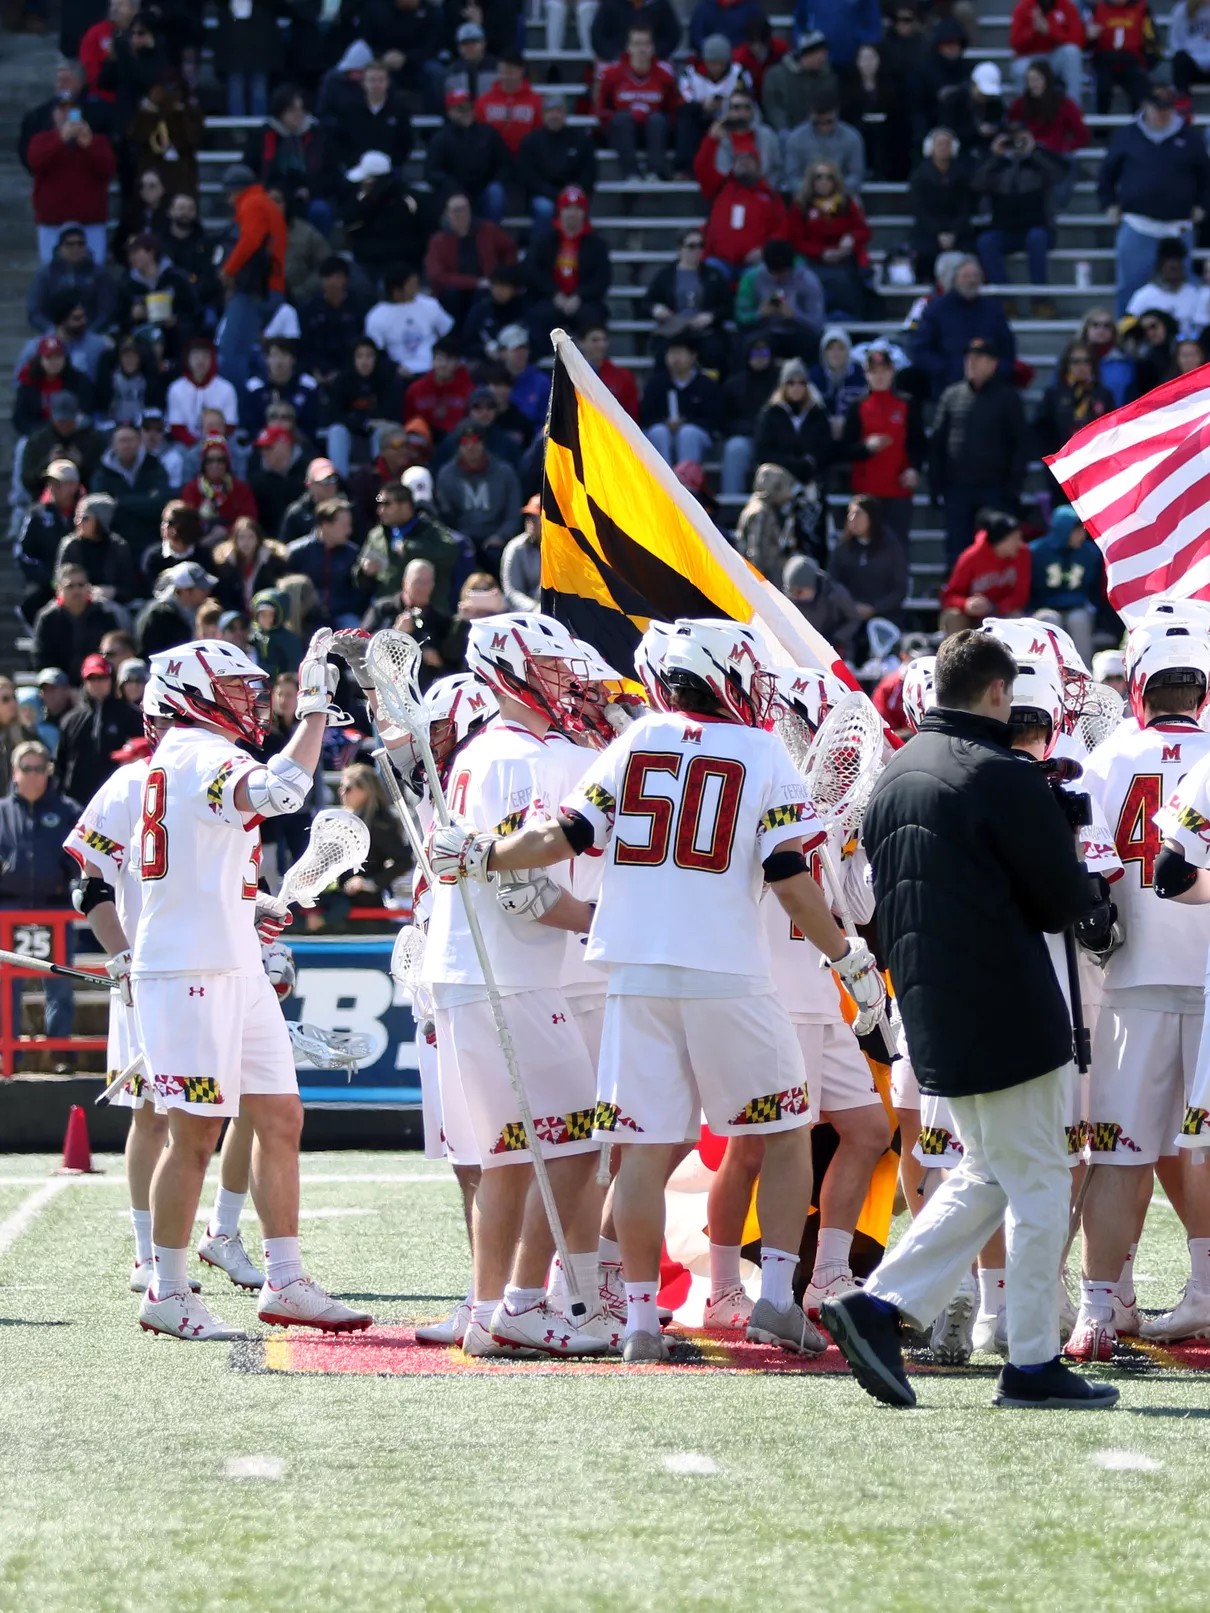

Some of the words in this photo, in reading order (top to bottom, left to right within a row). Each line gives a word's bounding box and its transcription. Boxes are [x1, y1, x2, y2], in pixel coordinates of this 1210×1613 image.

[463, 480, 490, 511] M
[490, 632, 509, 650] M
[1030, 638, 1047, 656] M
[728, 643, 748, 664] M
[165, 659, 183, 677] M
[792, 677, 810, 694] M
[467, 692, 487, 711] M
[681, 724, 704, 744] M
[1161, 743, 1181, 761] M
[614, 750, 746, 873] 50
[141, 767, 168, 881] 8
[1113, 773, 1187, 888] 4
[14, 930, 51, 959] 25
